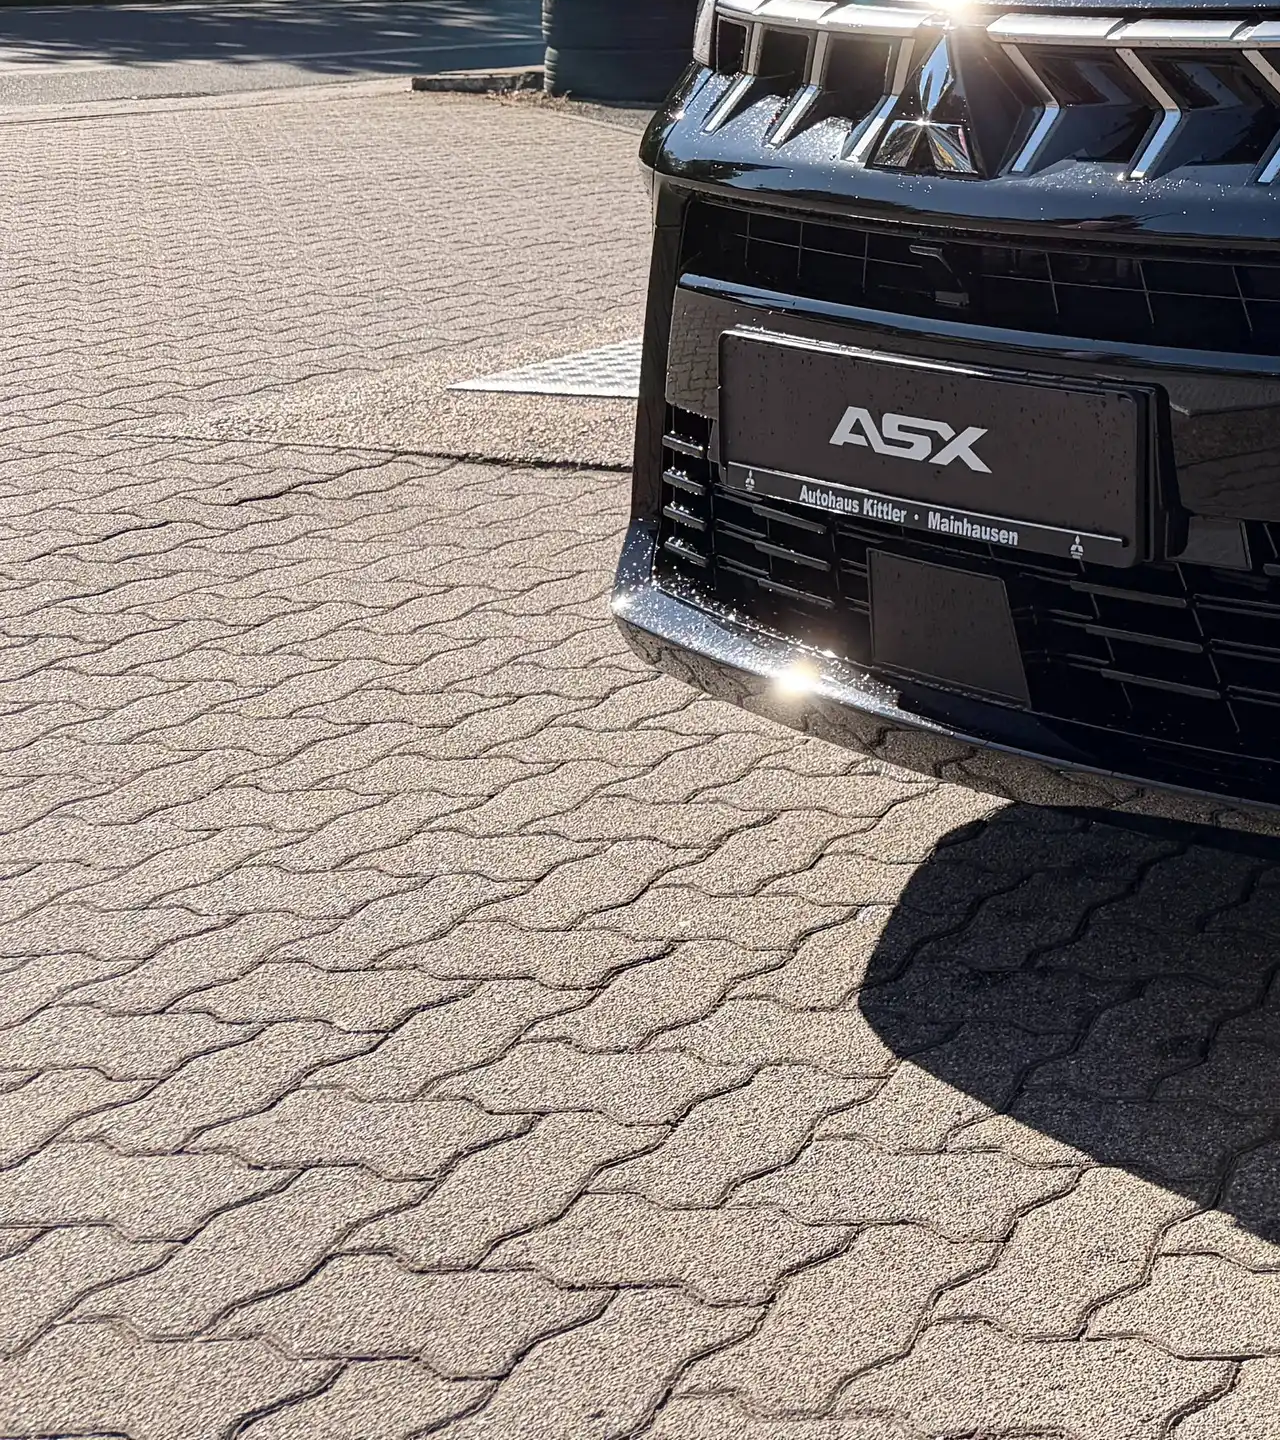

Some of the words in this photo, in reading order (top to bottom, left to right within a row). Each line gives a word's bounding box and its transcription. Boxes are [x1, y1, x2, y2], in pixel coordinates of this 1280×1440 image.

[829, 406, 993, 474] ASX
[799, 484, 860, 513] Autohaus
[863, 497, 908, 524] Kittler
[927, 510, 1019, 546] Mainhausen
